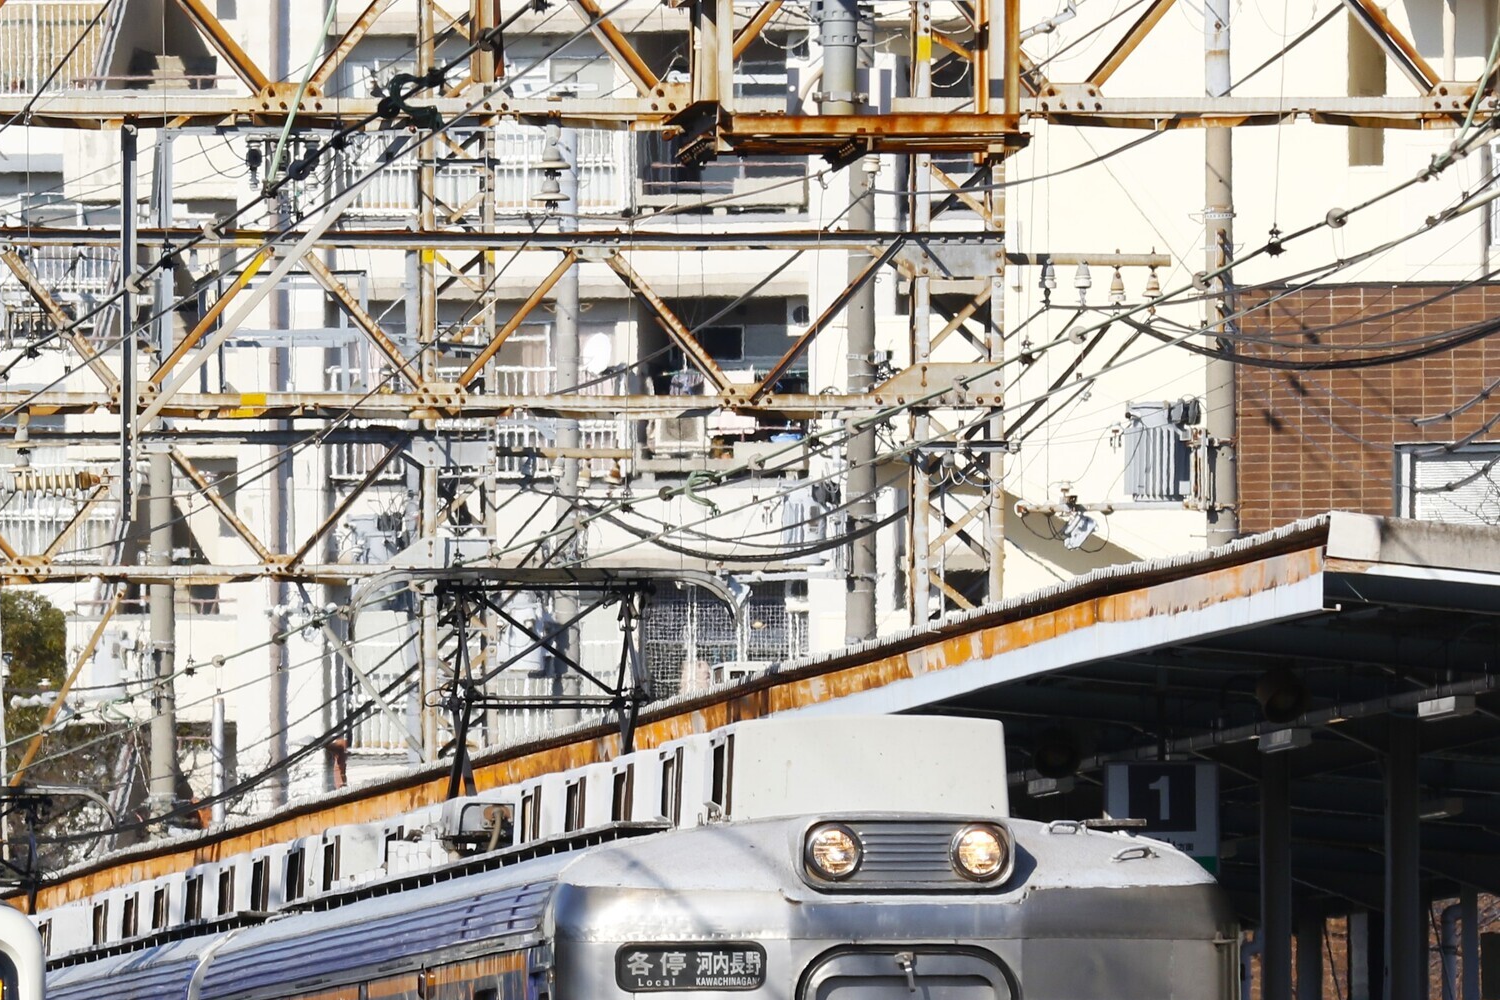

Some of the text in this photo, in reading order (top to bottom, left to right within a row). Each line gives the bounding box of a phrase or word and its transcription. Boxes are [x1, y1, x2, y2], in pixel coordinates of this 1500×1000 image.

[1148, 775, 1170, 820] 1
[626, 951, 761, 976] 各停 河内長野
[637, 977, 676, 987] Local
